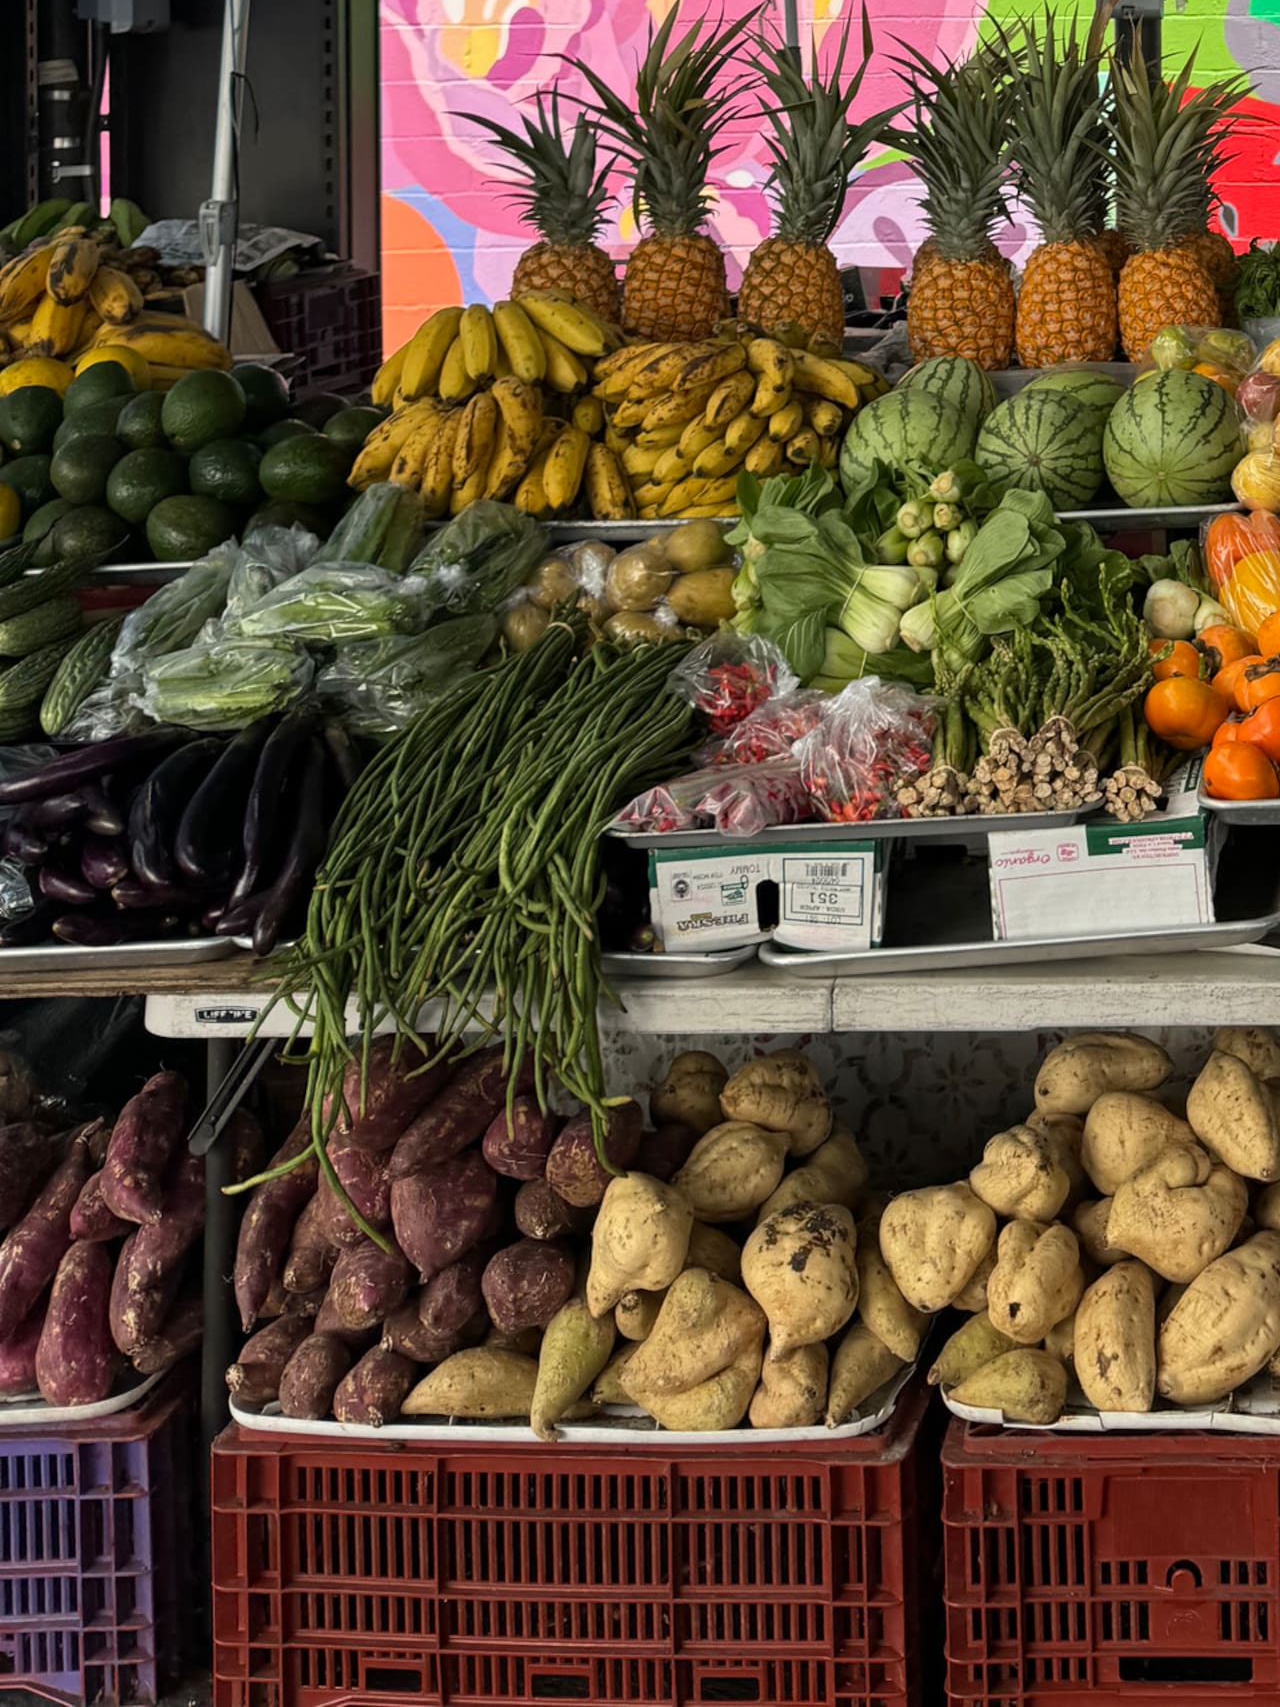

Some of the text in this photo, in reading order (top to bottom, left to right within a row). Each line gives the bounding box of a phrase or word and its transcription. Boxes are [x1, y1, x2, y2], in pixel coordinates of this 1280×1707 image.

[995, 850, 1051, 870] Organic
[729, 863, 761, 875] TOMMY
[809, 892, 838, 904] 351
[676, 913, 749, 931] FRESKA
